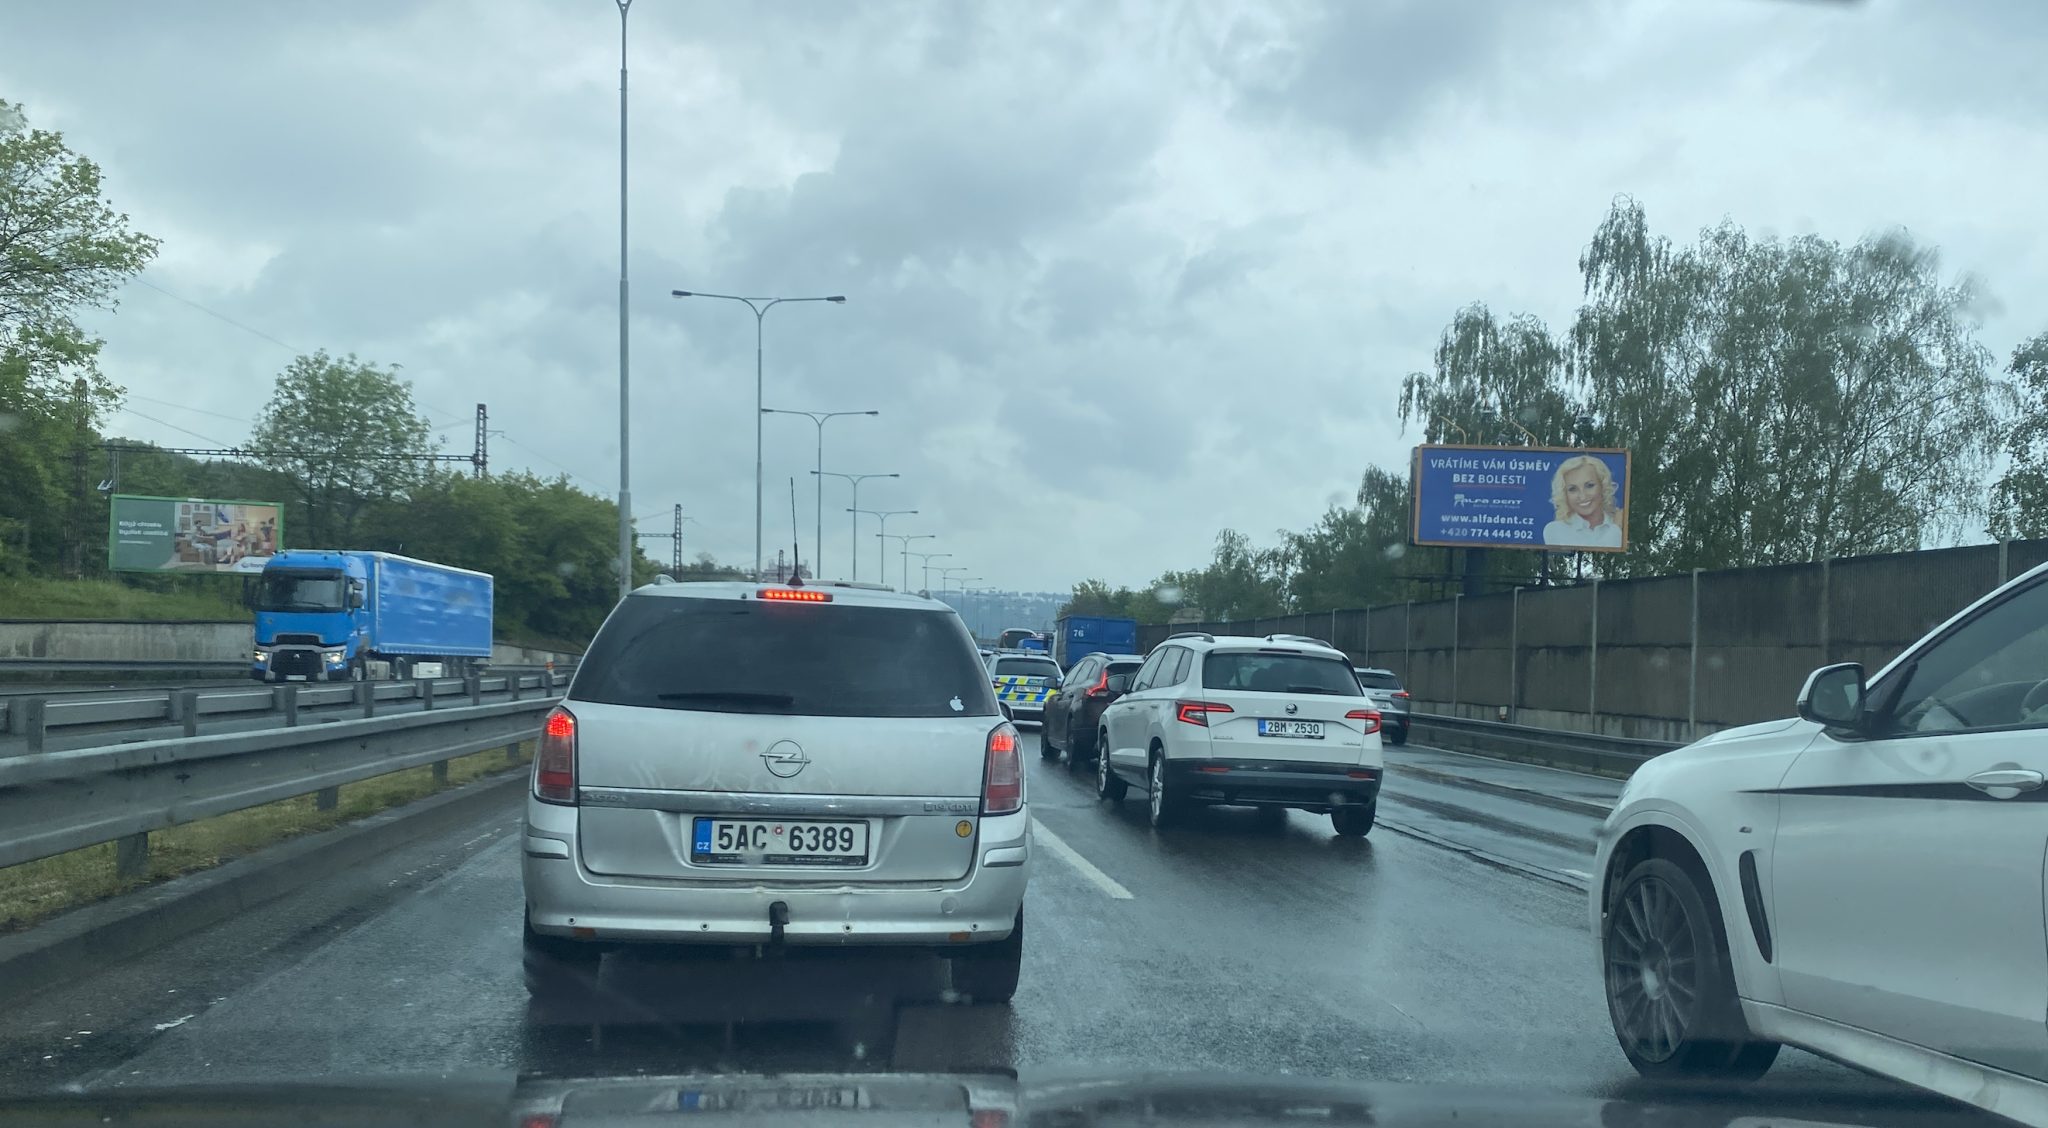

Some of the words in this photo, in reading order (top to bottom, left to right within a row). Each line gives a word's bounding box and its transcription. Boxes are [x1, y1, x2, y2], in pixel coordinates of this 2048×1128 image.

[1431, 457, 1479, 470] VRÁTÍME
[1483, 458, 1506, 471] VÁM
[1509, 459, 1551, 472] ÚSMĚV
[1453, 473, 1475, 484] BEZ
[1478, 474, 1526, 485] BOLESTI
[1441, 514, 1535, 526] www.alfadent.cz
[1440, 528, 1468, 537] +420
[1470, 529, 1490, 538] 774
[1491, 529, 1511, 539] 444
[1513, 530, 1533, 540] 902
[1073, 629, 1084, 638] 76
[1268, 721, 1287, 733] 2BM
[1294, 723, 1320, 734] 2530
[718, 824, 767, 851] 5AC
[789, 825, 854, 852] 6389
[696, 841, 710, 851] CZ
